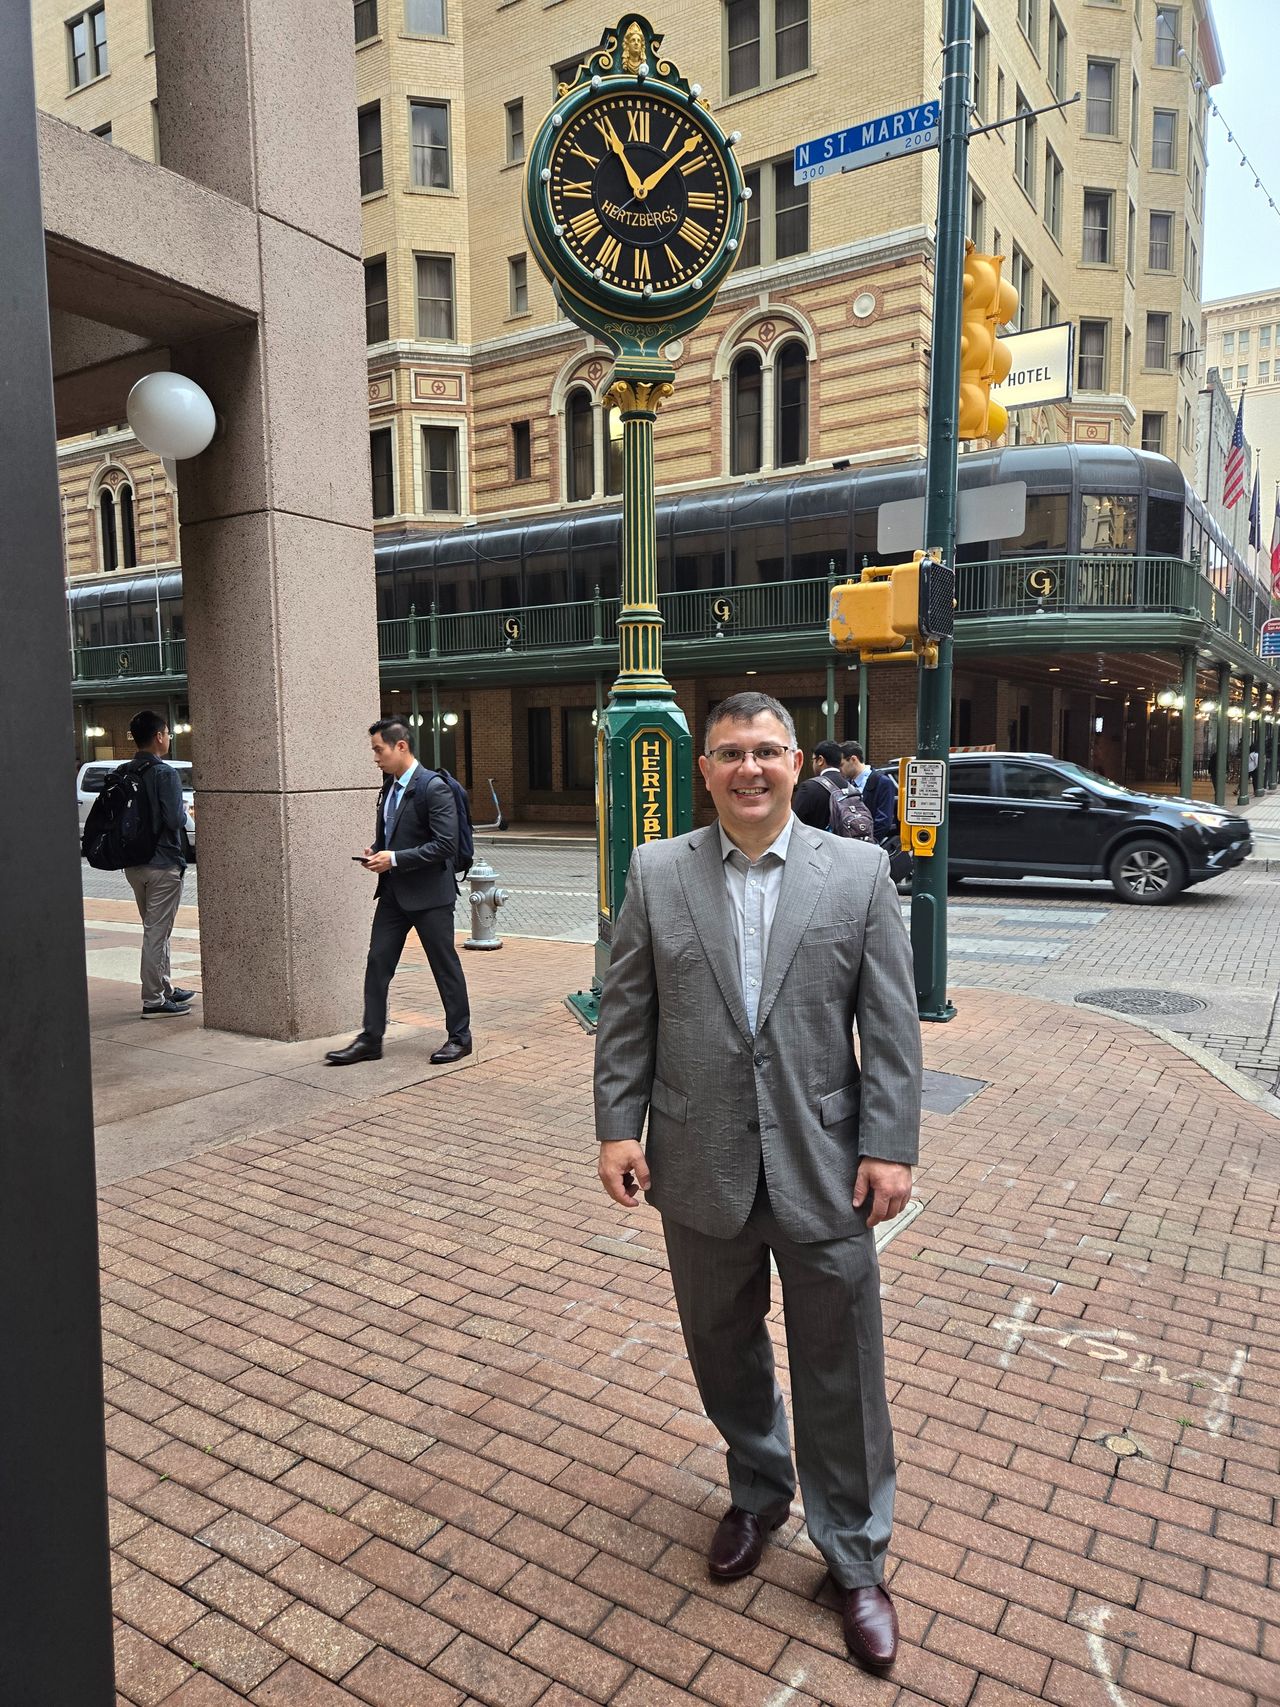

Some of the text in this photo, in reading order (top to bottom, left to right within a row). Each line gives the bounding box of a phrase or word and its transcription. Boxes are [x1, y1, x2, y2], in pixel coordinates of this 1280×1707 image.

[627, 110, 650, 143] XII
[799, 105, 935, 167] N ST MARYS
[905, 131, 932, 149] 200
[570, 142, 600, 169] X
[802, 165, 825, 181] 300
[601, 199, 678, 227] HERTZBERG'S
[687, 192, 716, 210] III
[664, 243, 684, 273] V
[1008, 366, 1051, 387] HOTEL
